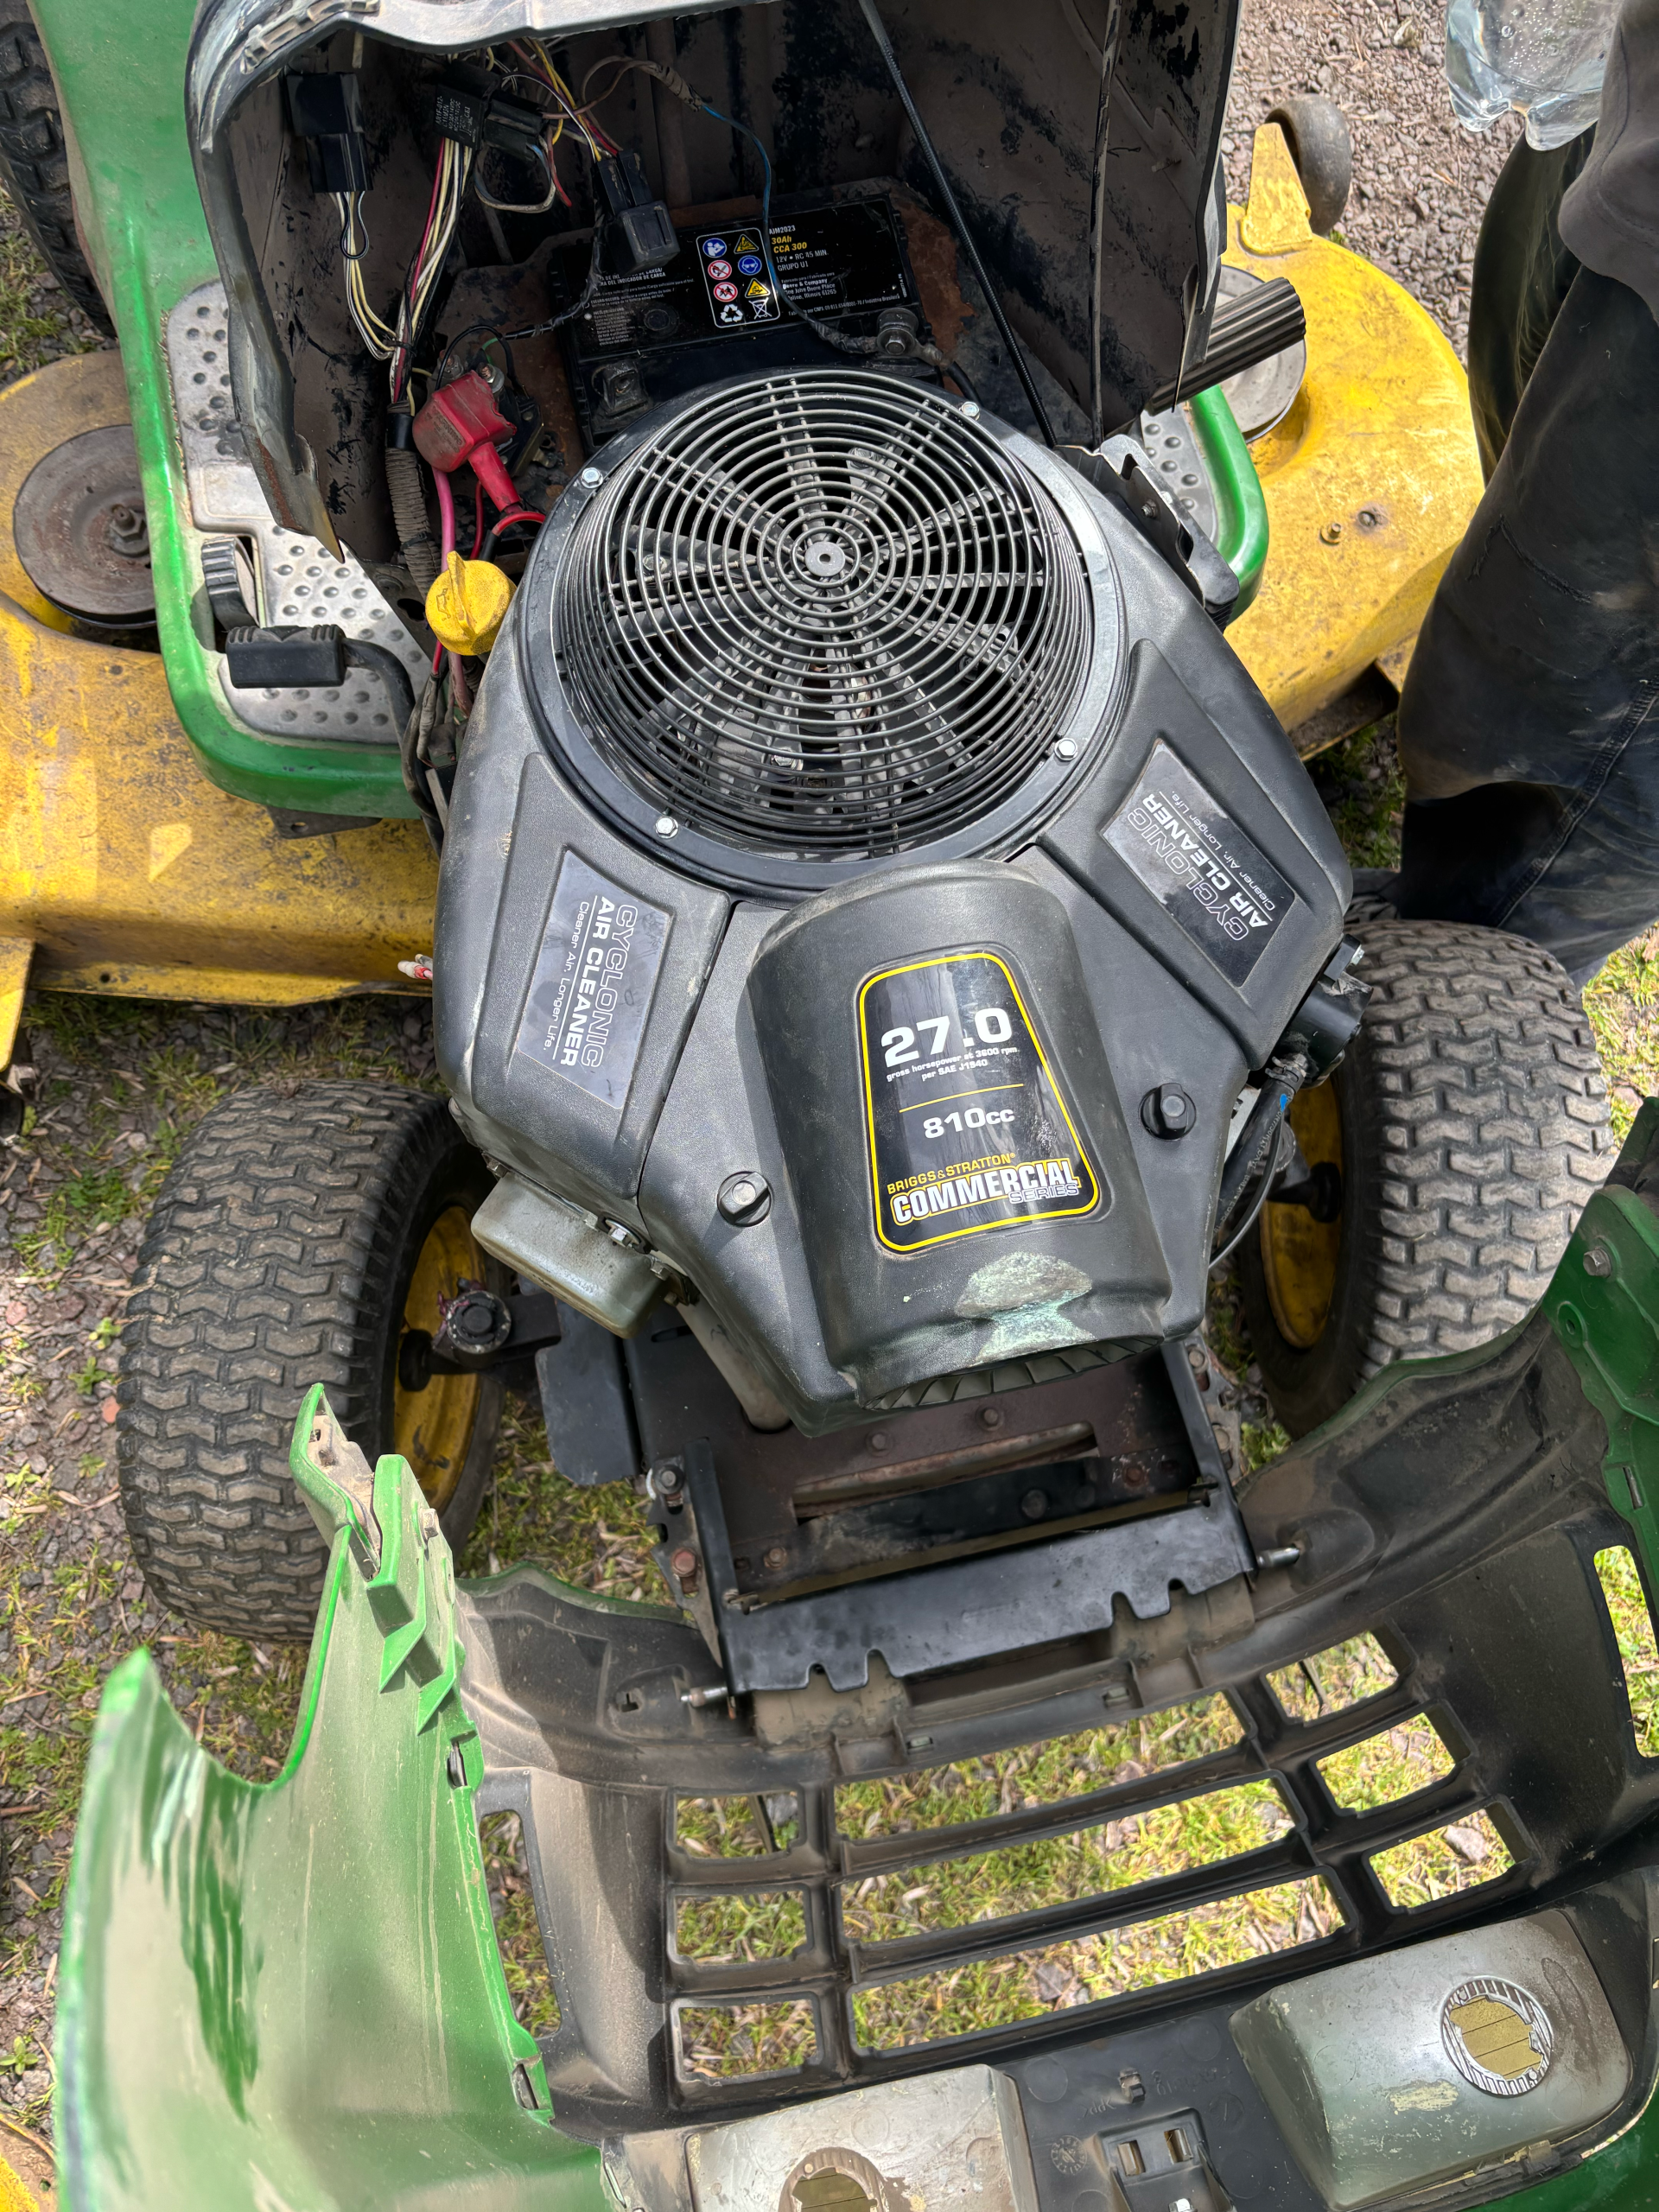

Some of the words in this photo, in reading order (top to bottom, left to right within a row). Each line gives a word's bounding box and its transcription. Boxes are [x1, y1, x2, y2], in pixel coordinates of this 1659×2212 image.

[772, 235, 791, 245] 30Ah
[773, 245, 790, 253] CCA
[791, 242, 807, 251] 300
[778, 262, 798, 271] GRUPO
[1171, 790, 1190, 814] Life.
[1142, 793, 1232, 891] CLEANER
[1188, 813, 1223, 850] Longer
[1127, 807, 1249, 941] CYCLONIC
[1223, 850, 1241, 869] Air.
[1238, 871, 1275, 912] Cleaner
[571, 900, 590, 949] Cleaner
[592, 896, 616, 940] AIR
[1229, 891, 1268, 930] AIR
[564, 951, 576, 973] Air.
[552, 977, 570, 1022] Longer
[581, 904, 638, 1068] CYCLONIC
[560, 947, 604, 1066] CLEANER
[543, 1027, 560, 1051] Life.
[880, 1007, 1013, 1068] 27.0
[887, 1069, 910, 1082] gross
[912, 1054, 962, 1072] horsepower
[964, 1051, 974, 1059] at
[976, 1048, 999, 1058] 3600
[922, 1071, 936, 1081] per
[938, 1065, 957, 1075] SAE
[923, 1107, 1015, 1139] 810cc
[893, 1160, 1079, 1223] COMMERCIAL
[1007, 1183, 1079, 1205] SERIES
